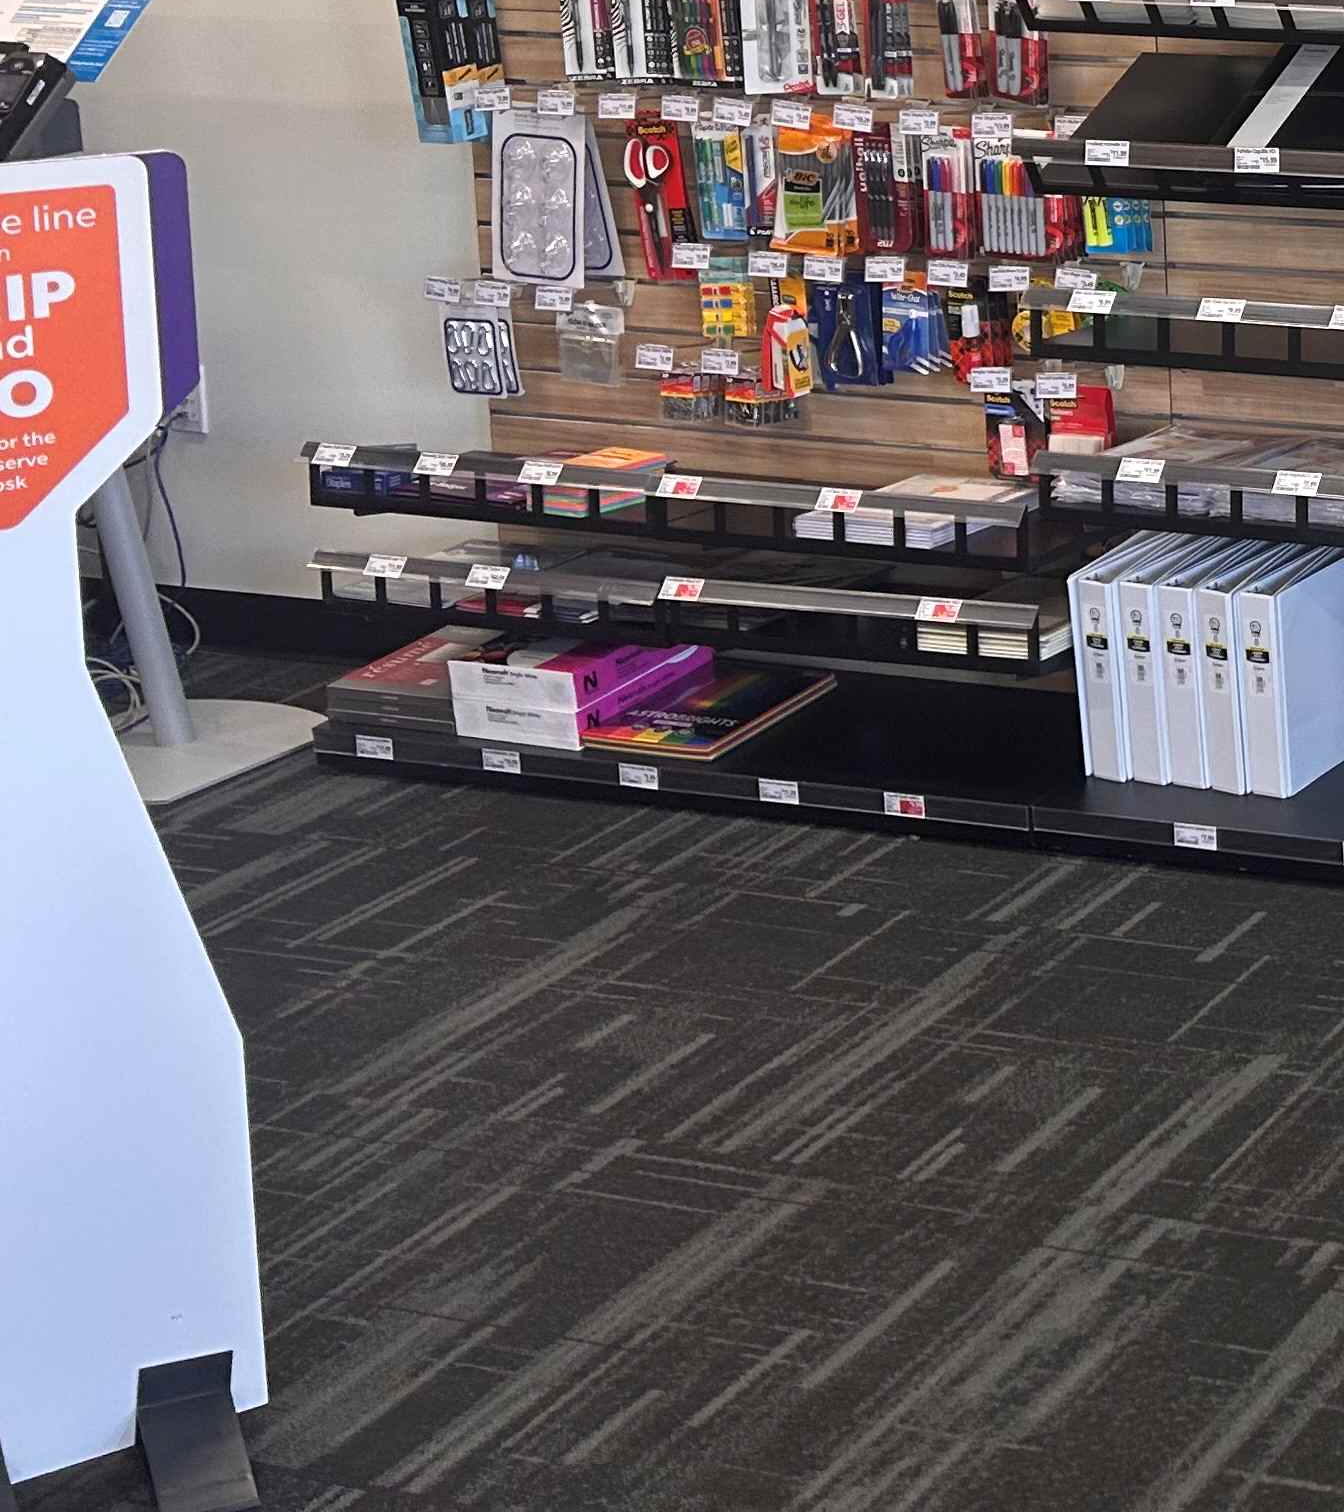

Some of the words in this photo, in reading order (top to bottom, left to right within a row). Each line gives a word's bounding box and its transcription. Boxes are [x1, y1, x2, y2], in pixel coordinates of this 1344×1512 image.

[637, 126, 666, 135] Scotch
[32, 205, 97, 233] line
[5, 270, 76, 322] IP
[1050, 400, 1077, 408] Scotch
[22, 431, 57, 446] the
[0, 454, 49, 472] serve
[0, 477, 28, 491] osk
